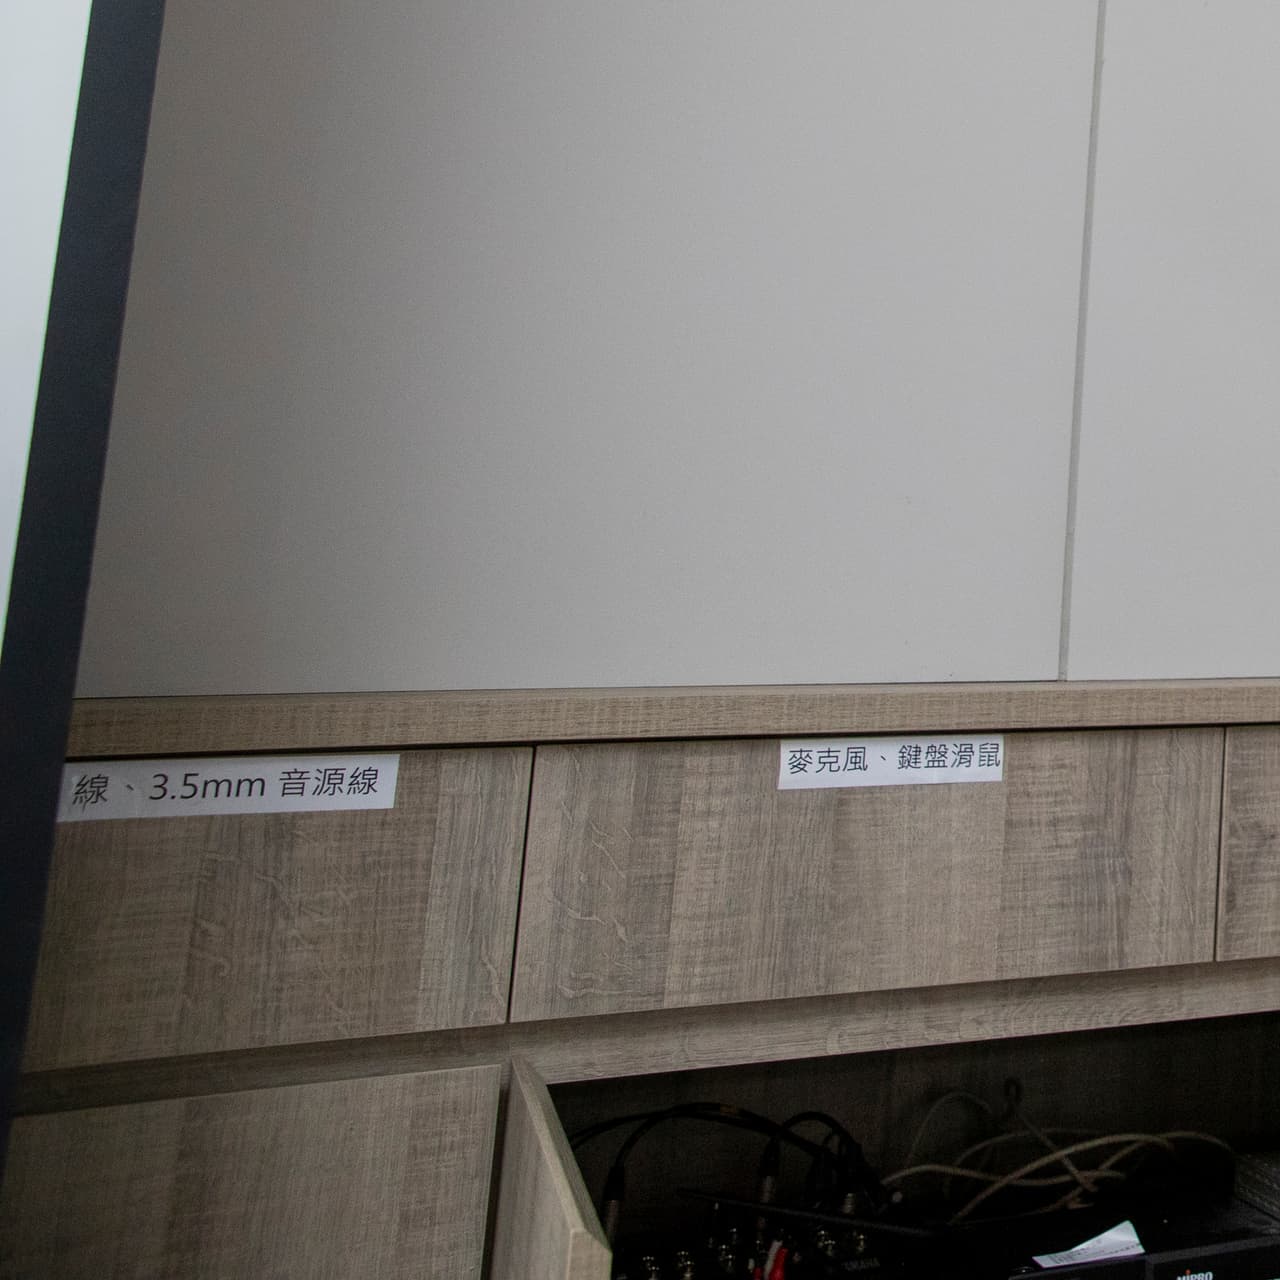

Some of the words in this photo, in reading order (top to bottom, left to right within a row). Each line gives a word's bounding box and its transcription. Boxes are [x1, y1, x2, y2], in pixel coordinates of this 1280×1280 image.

[786, 741, 1002, 775] 麥克風、鍵盤滑鼠
[277, 765, 380, 798] 音源線
